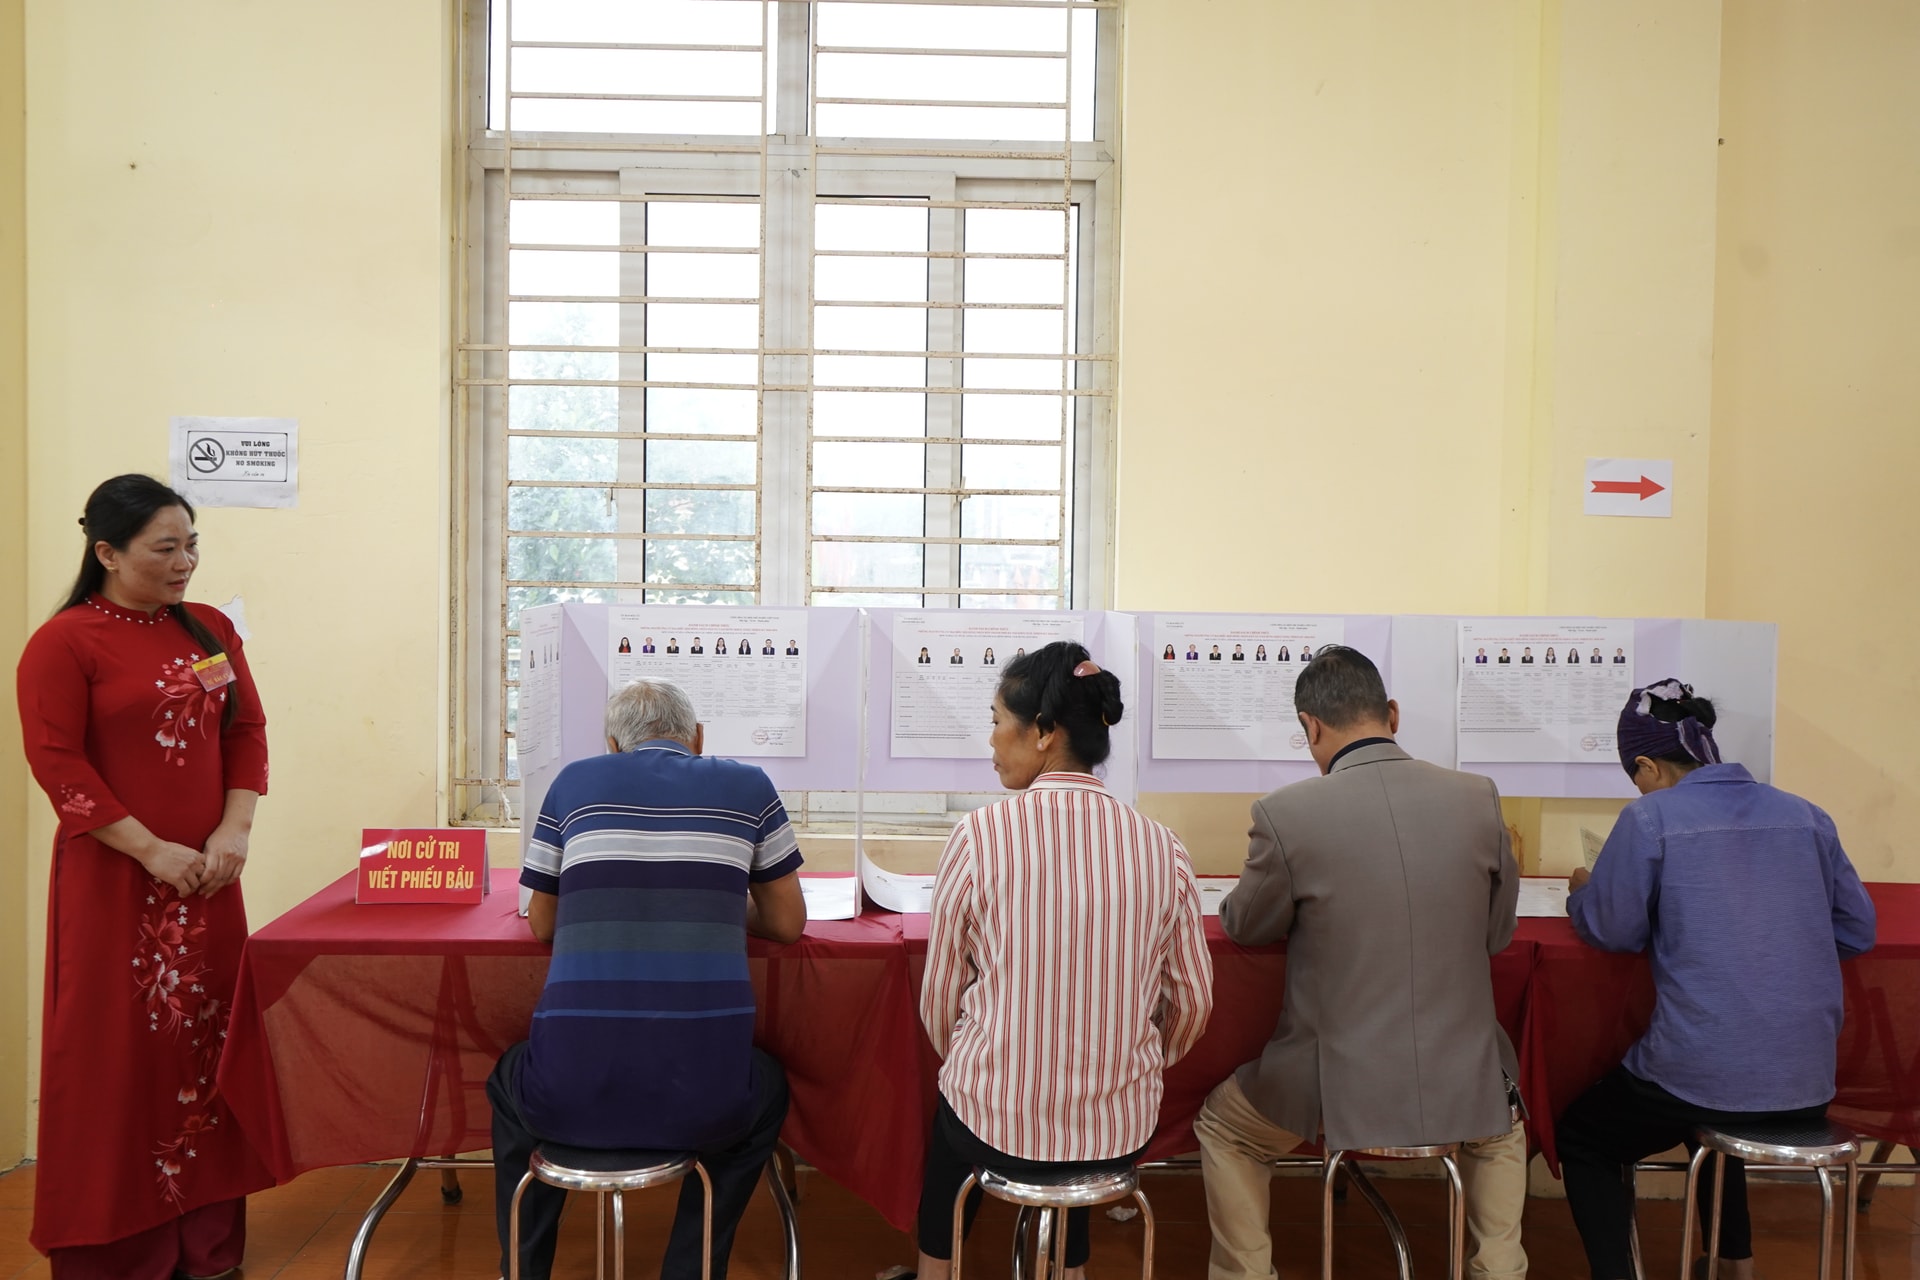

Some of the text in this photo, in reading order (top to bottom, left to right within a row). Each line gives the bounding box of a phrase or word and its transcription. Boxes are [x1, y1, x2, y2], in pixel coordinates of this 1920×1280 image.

[387, 835, 460, 859] NƠI CỬ TRI
[368, 864, 474, 889] VIẾT PHIẾU BẦU
